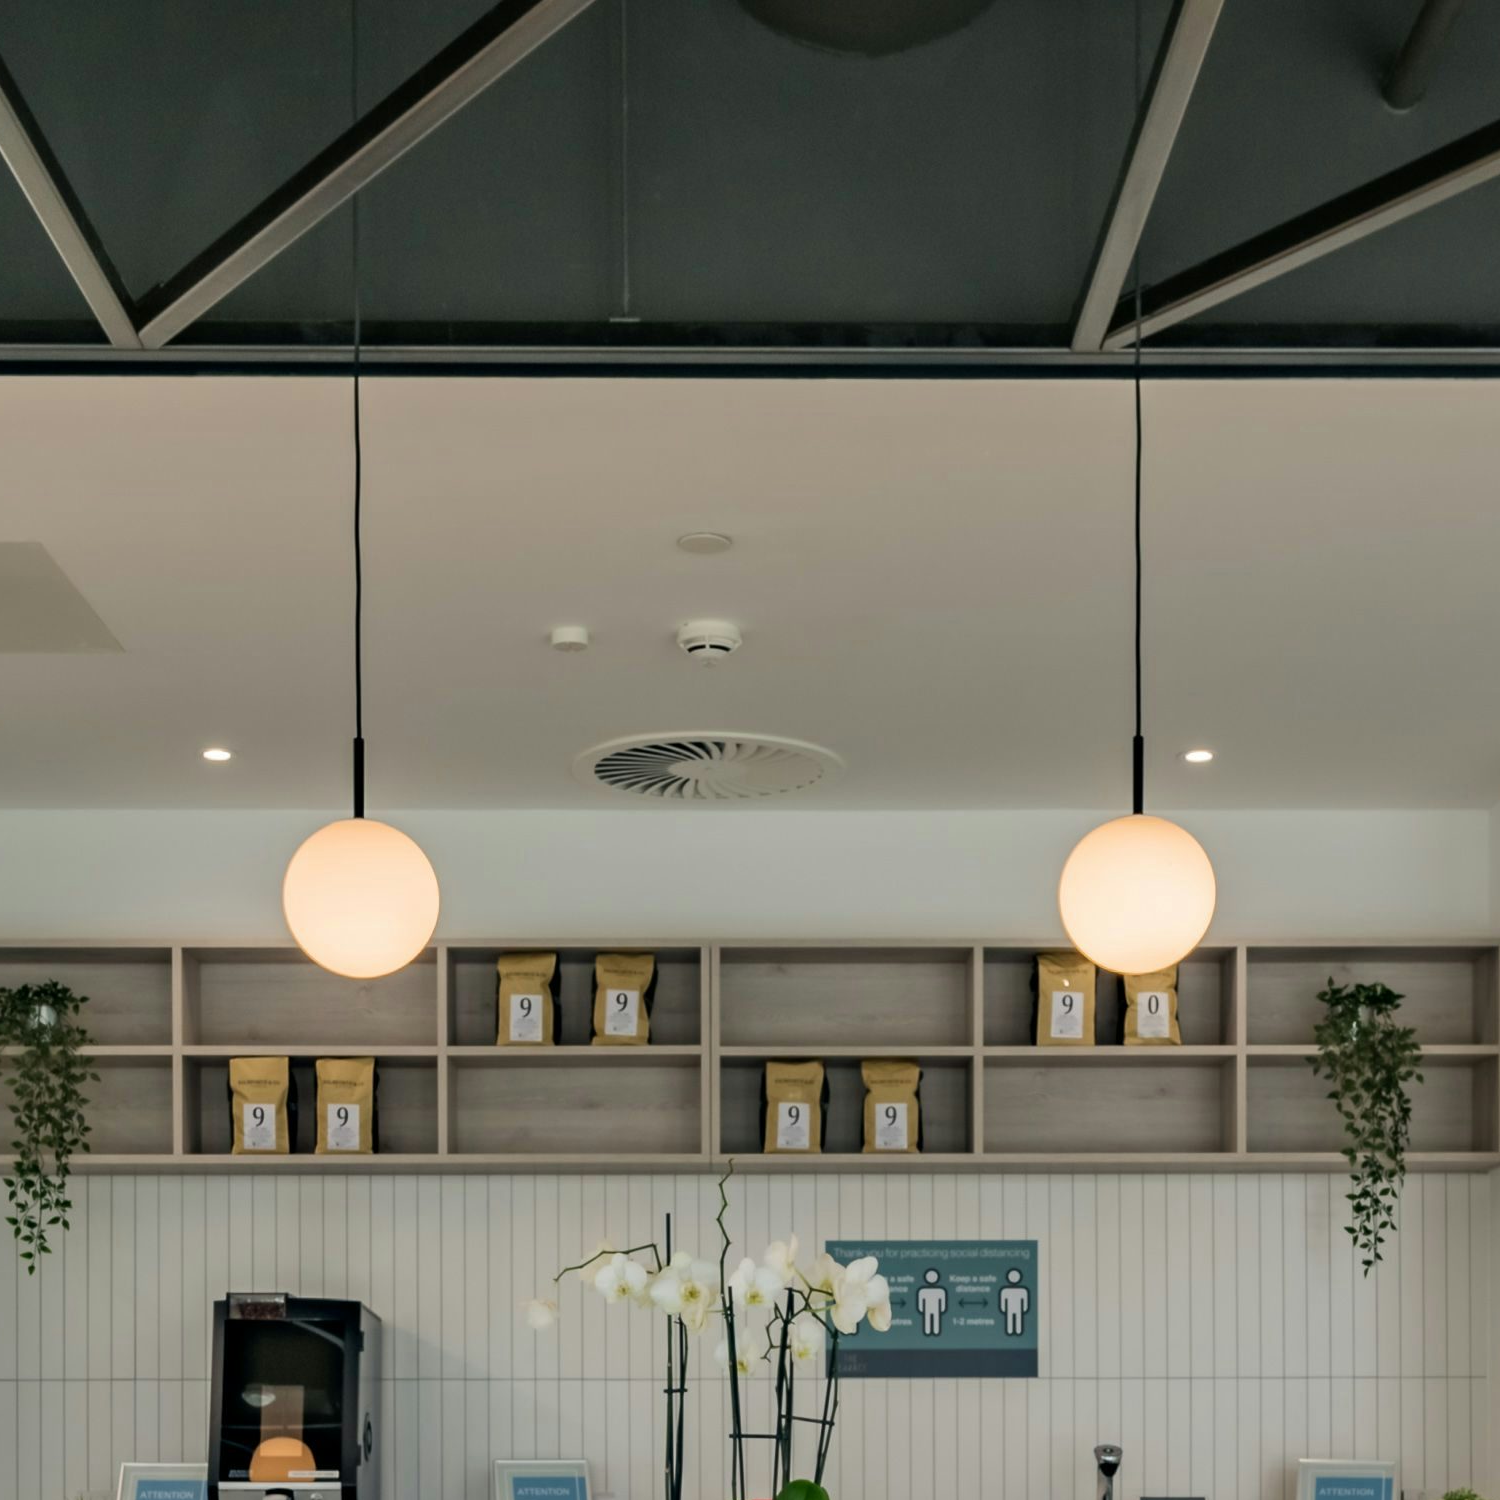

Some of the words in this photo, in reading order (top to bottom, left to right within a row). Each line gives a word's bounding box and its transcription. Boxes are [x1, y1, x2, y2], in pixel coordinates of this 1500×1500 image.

[519, 997, 532, 1018] 9
[615, 992, 628, 1013] 9
[1061, 994, 1074, 1015] 9
[1147, 994, 1160, 1015] 0
[252, 1106, 265, 1127] 9
[336, 1106, 349, 1127] 9
[787, 1105, 800, 1127] 9
[884, 1105, 897, 1127] 9
[833, 1247, 863, 1258] Thank
[865, 1249, 884, 1259] you
[885, 1247, 899, 1258] for
[900, 1247, 949, 1260] practicing
[950, 1247, 979, 1258] social
[980, 1247, 1030, 1260] distancing
[949, 1274, 971, 1285] Keep
[139, 1490, 195, 1500] ATTENTION
[516, 1487, 571, 1497] ATTENTION
[1318, 1487, 1375, 1497] ATTENTION
